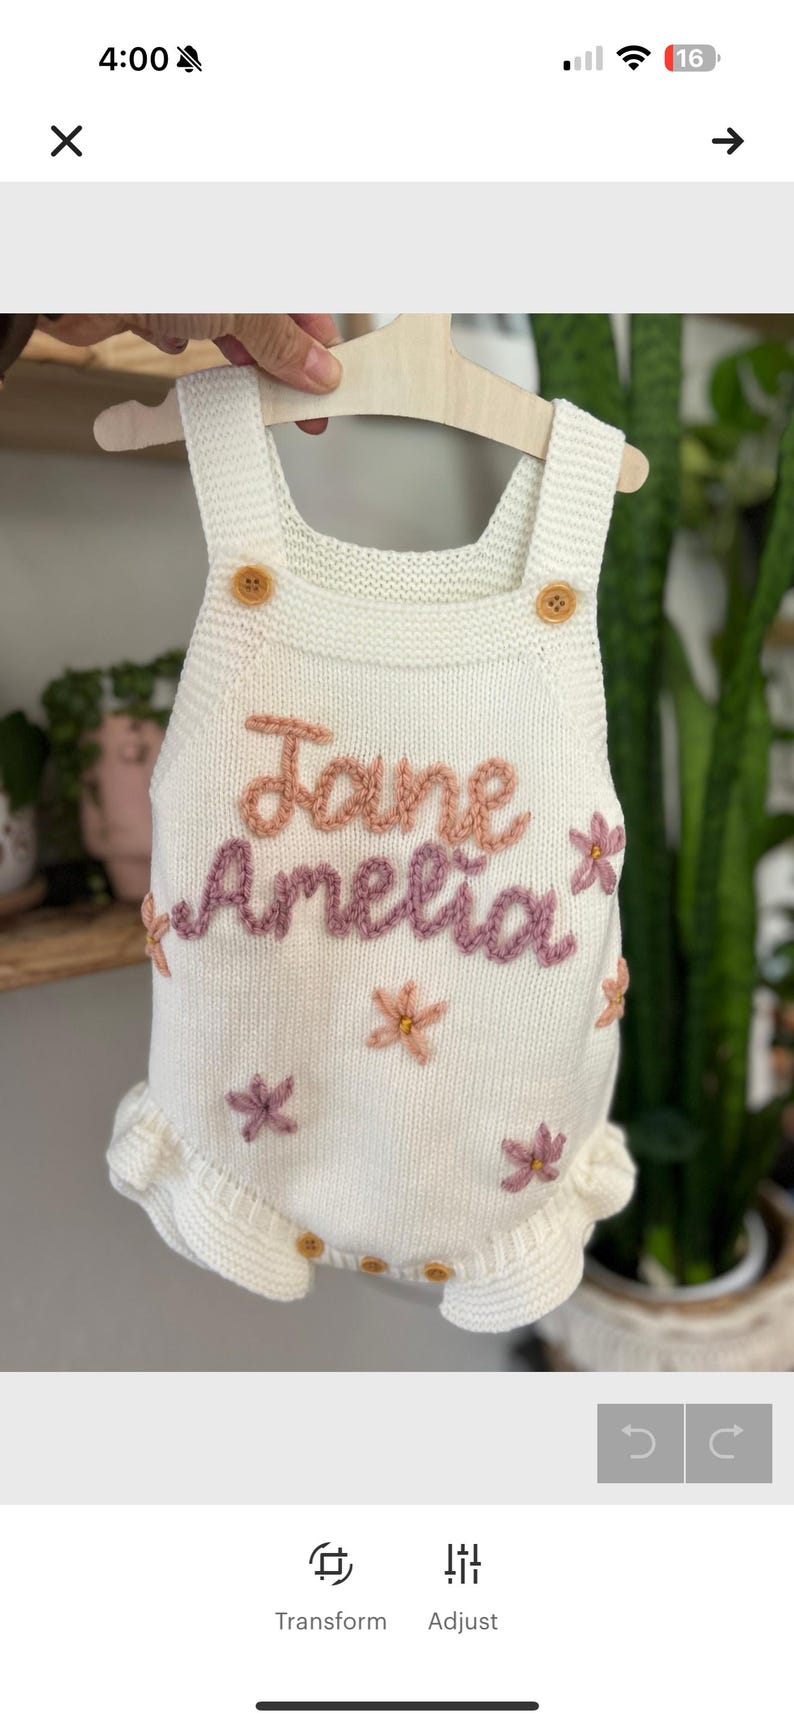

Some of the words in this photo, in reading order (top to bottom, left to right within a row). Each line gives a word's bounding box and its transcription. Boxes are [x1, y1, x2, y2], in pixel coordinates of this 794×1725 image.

[99, 47, 168, 71] 4:00
[677, 49, 703, 67] 16
[238, 714, 531, 853] Jane
[171, 837, 577, 968] Amelia
[275, 1611, 386, 1630] Transform
[428, 1611, 498, 1634] Adjust
